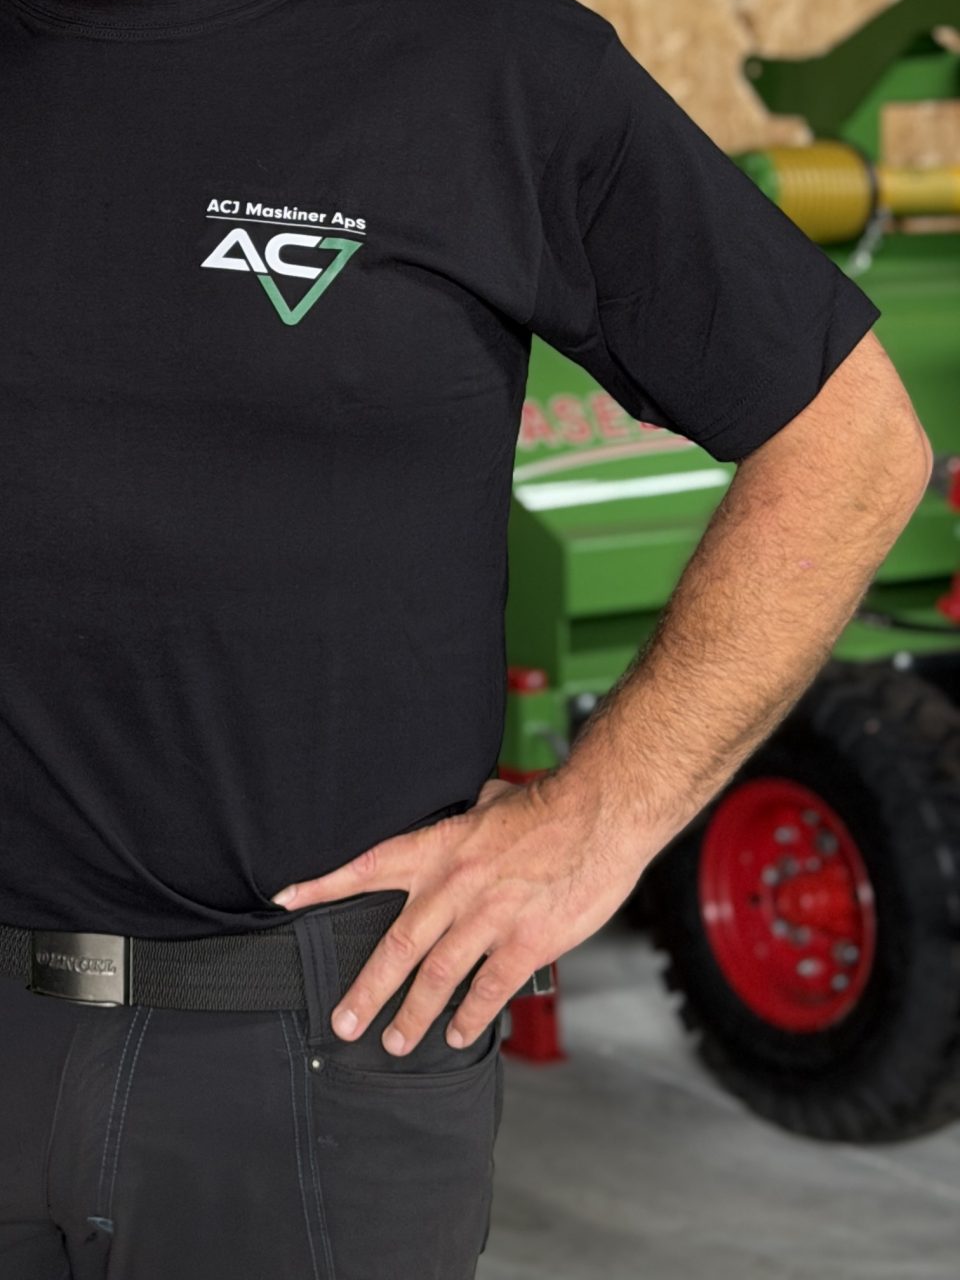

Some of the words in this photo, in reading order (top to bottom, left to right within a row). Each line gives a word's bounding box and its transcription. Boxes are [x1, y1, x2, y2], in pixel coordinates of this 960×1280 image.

[206, 198, 241, 215] ACJ
[245, 202, 327, 223] Maskiner
[331, 211, 367, 230] ApS
